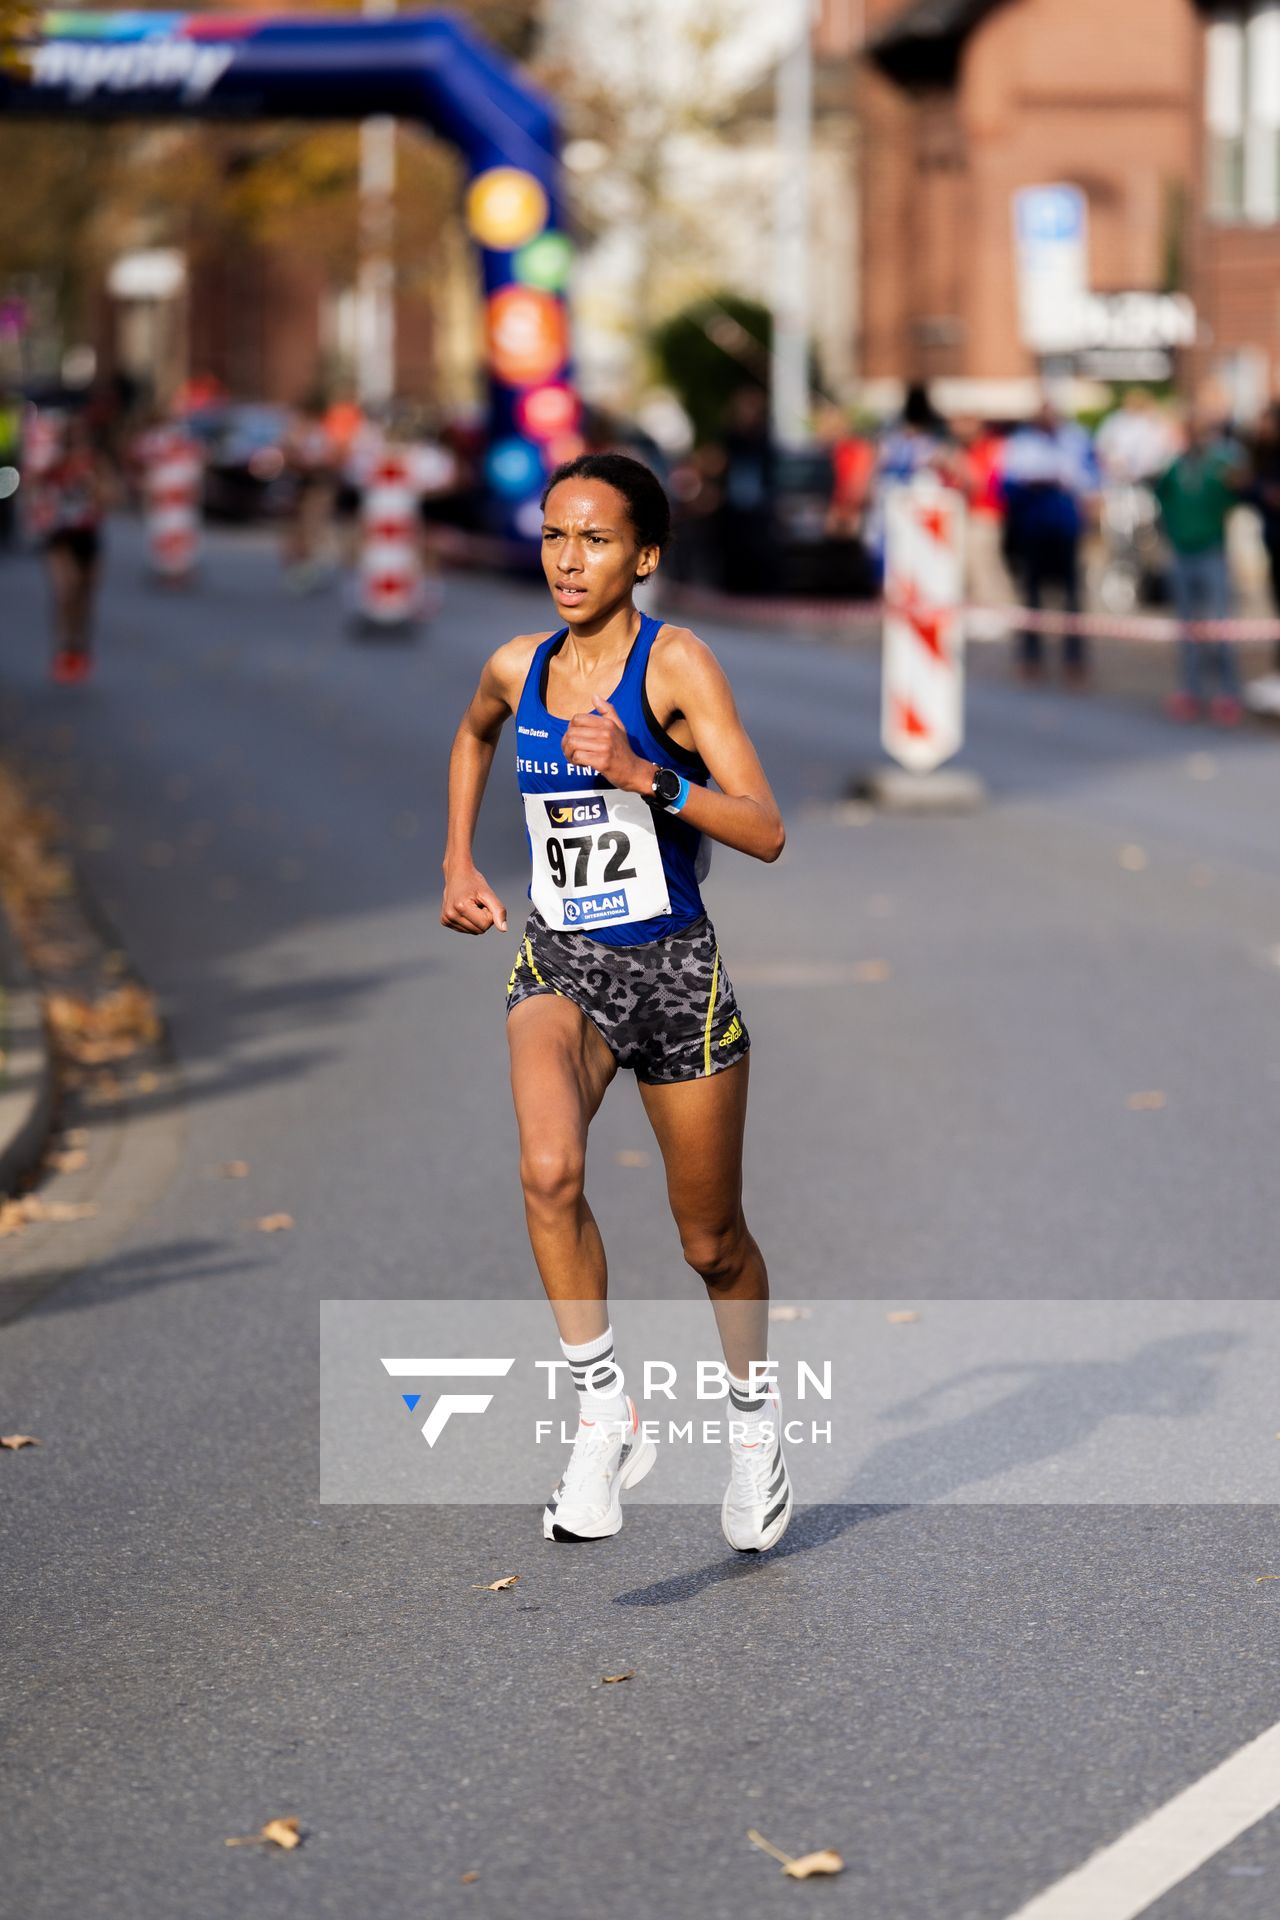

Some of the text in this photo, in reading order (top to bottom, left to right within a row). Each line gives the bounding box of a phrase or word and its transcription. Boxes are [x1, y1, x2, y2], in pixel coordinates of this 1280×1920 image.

[573, 804, 601, 821] GLS
[546, 830, 638, 889] 972
[582, 895, 625, 914] PLAN
[584, 909, 627, 920] INTERNATIONAL
[719, 1028, 742, 1047] adid
